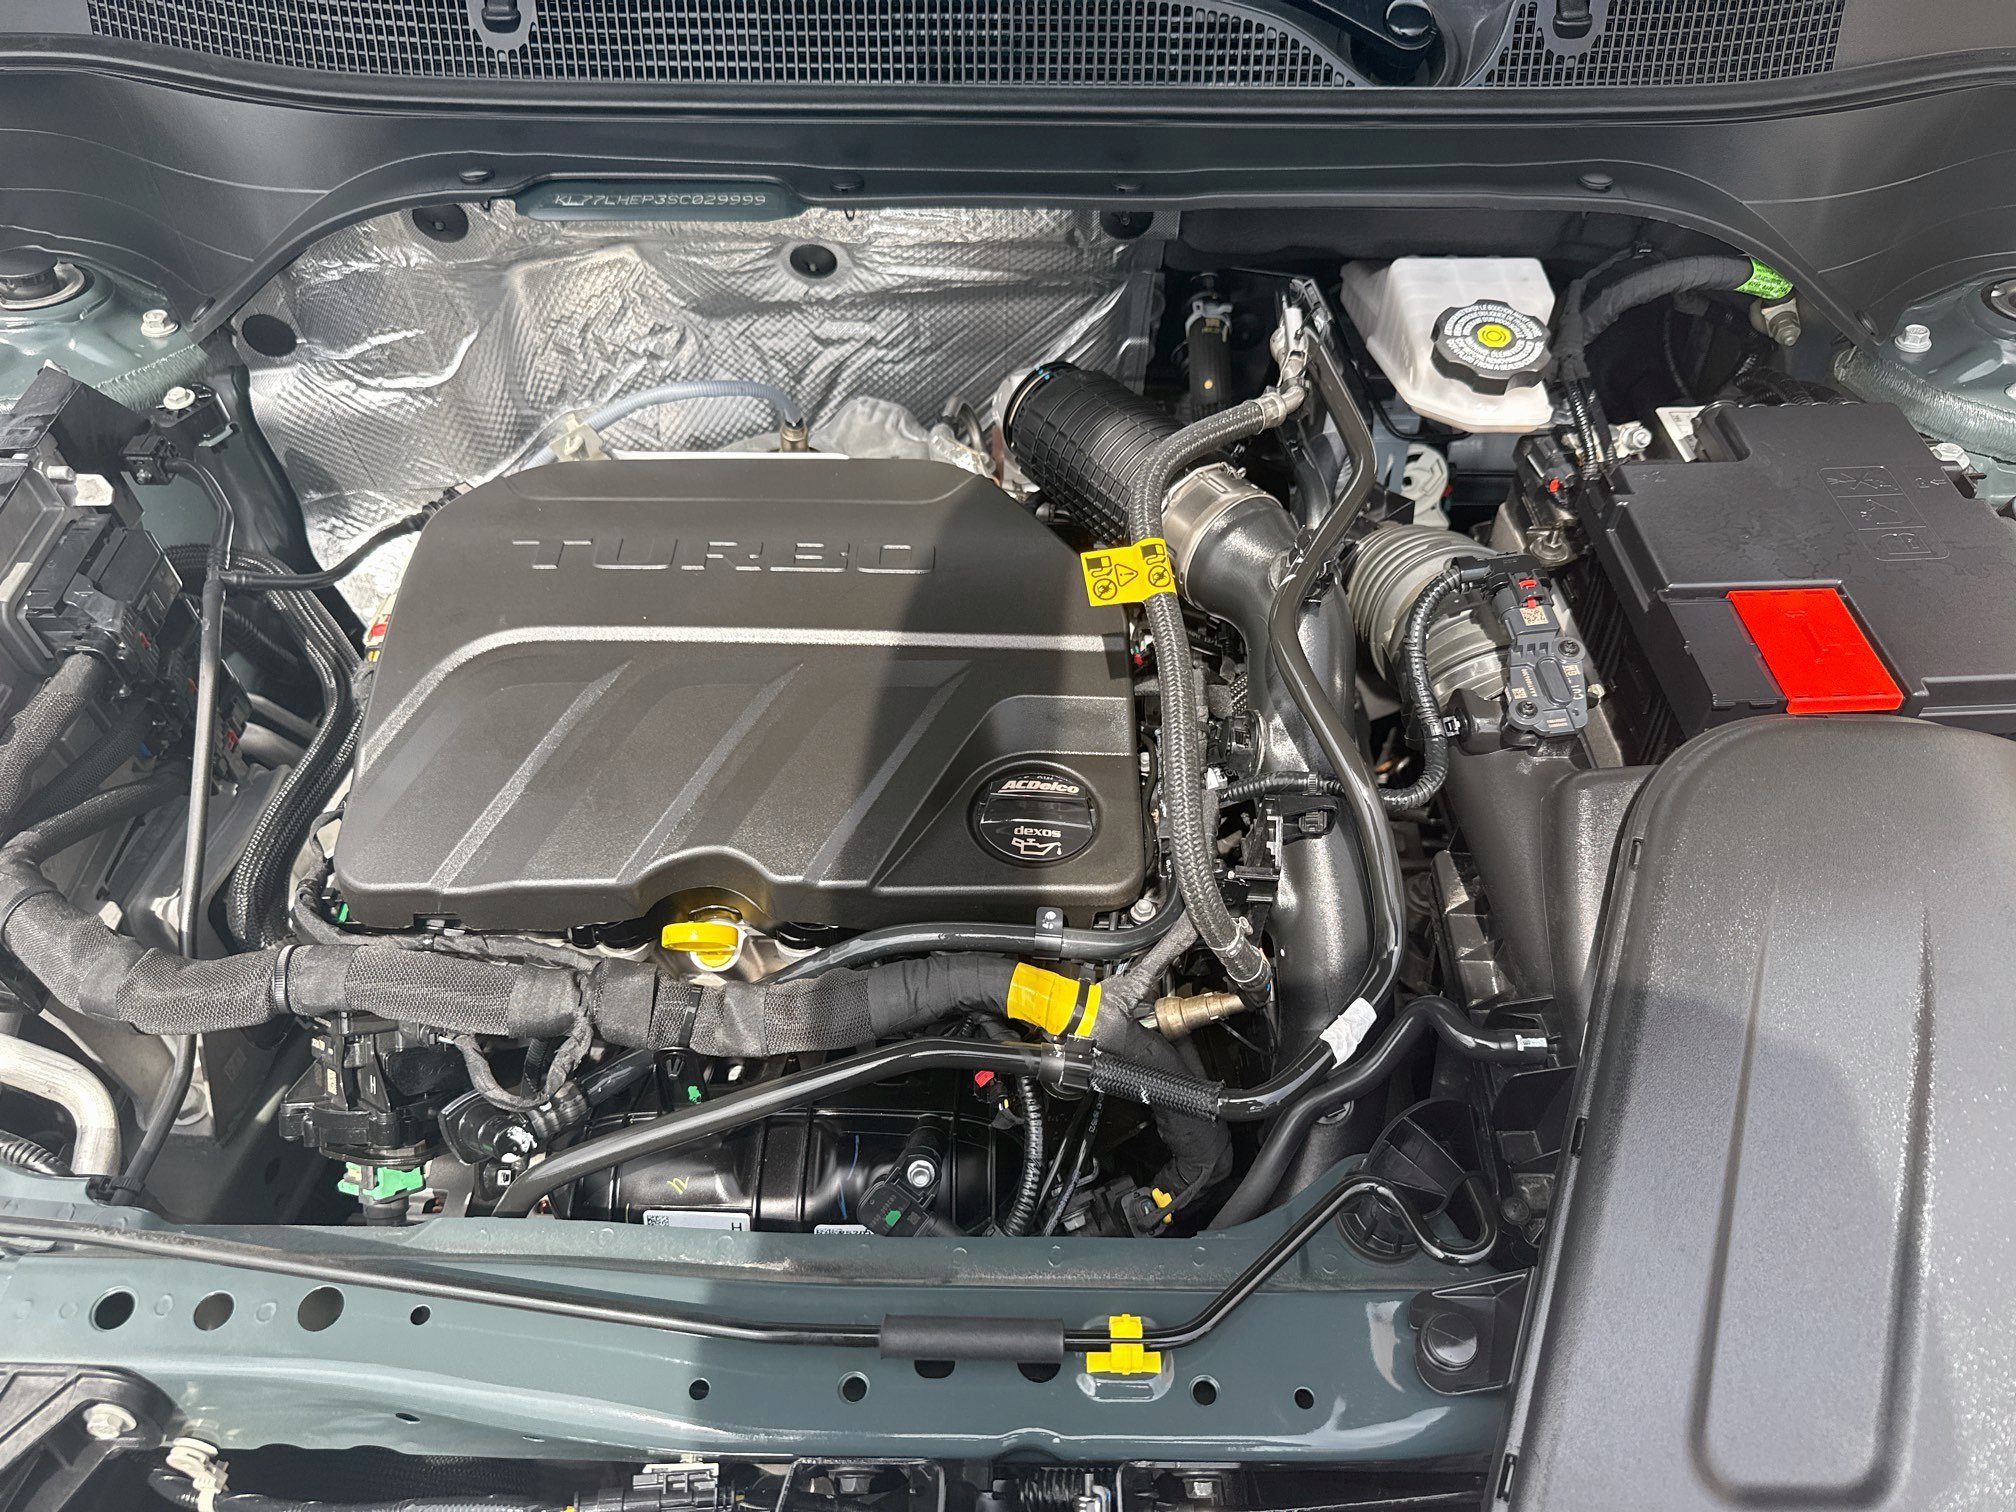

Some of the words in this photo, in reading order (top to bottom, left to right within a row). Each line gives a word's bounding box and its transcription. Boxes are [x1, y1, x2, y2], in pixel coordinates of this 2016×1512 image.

[511, 537, 937, 575] TURBO
[1001, 780, 1080, 794] ACDelco
[1013, 825, 1062, 838] dexos
